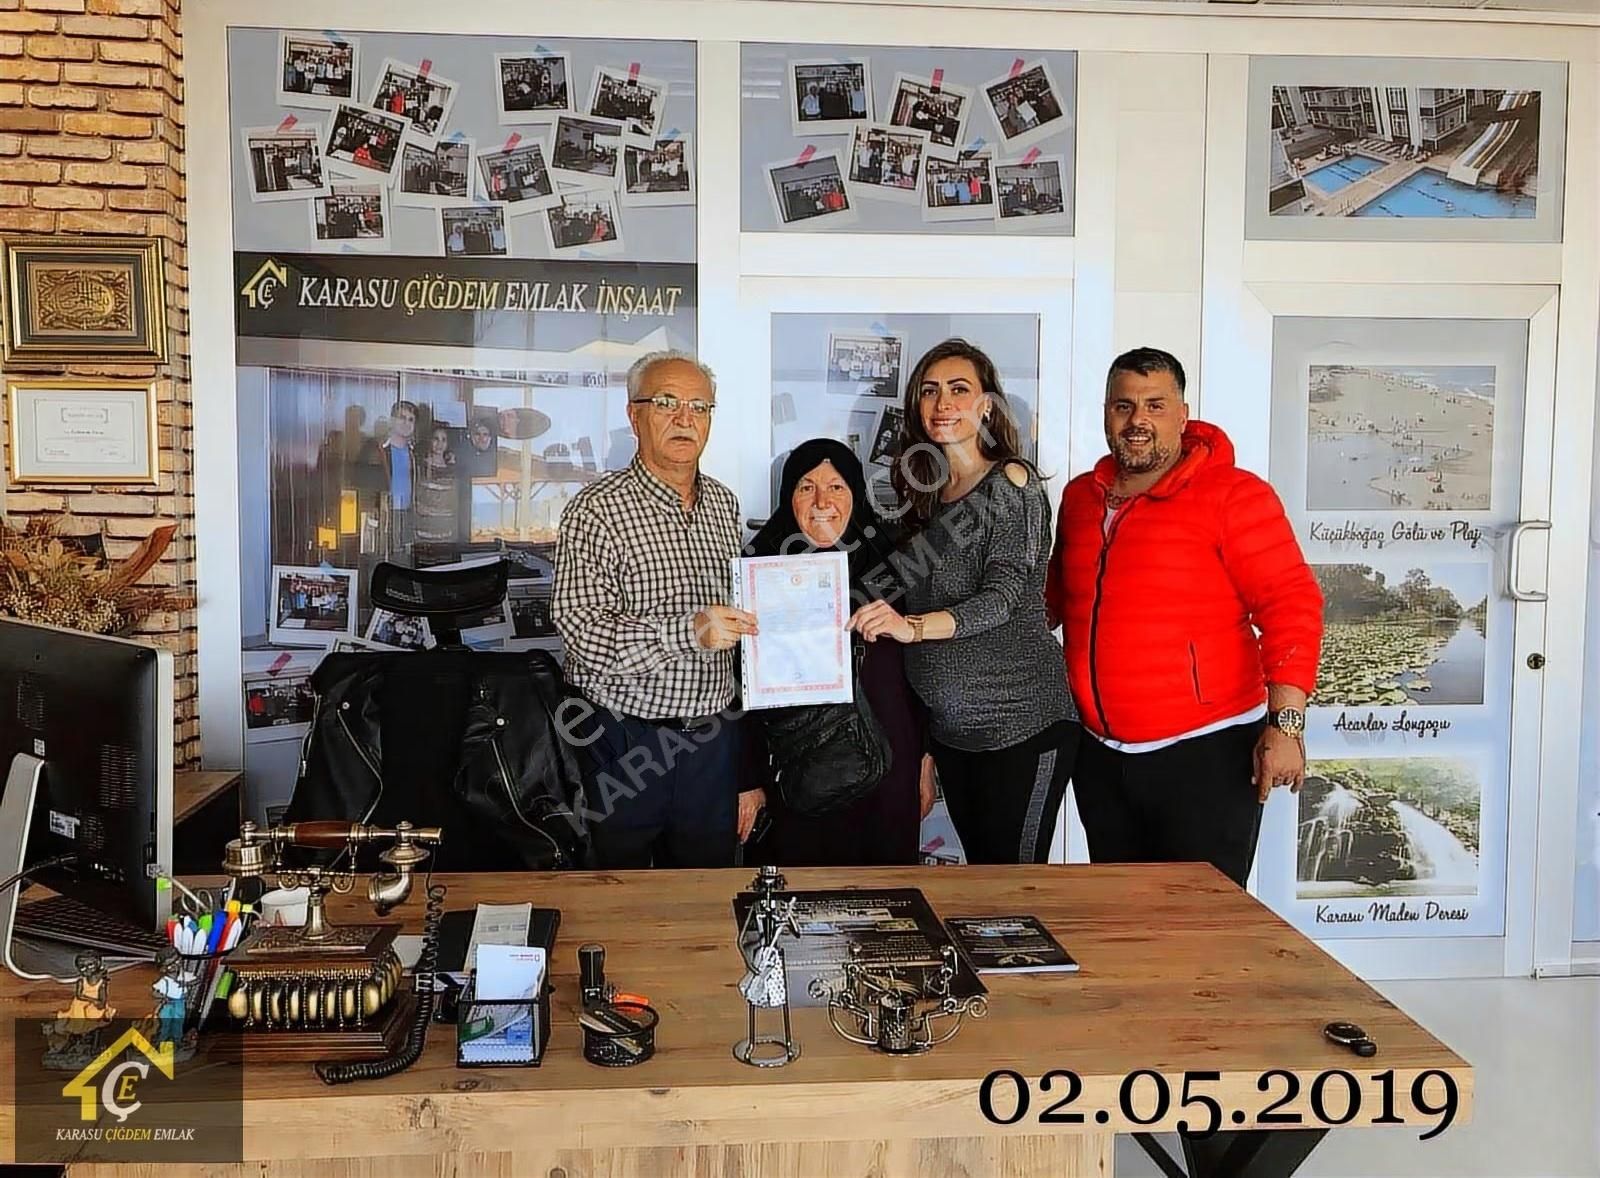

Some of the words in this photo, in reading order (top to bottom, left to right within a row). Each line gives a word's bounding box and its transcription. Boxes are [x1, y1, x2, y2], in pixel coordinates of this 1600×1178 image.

[299, 276, 399, 308] KARASU
[404, 273, 500, 315] ÇİĞDEM
[503, 280, 588, 313] EMLAK
[595, 278, 682, 322] İNŞAAT
[1310, 520, 1384, 549] Küçükboğaz
[1392, 521, 1428, 541] Gölü
[1430, 529, 1446, 541] ve
[1450, 520, 1482, 549] Plaj
[1333, 711, 1388, 732] Acarlar
[1392, 710, 1450, 738] Longozu
[1316, 904, 1365, 924] Karasu
[1368, 902, 1420, 922] Maden
[1425, 901, 1469, 921] Deresi
